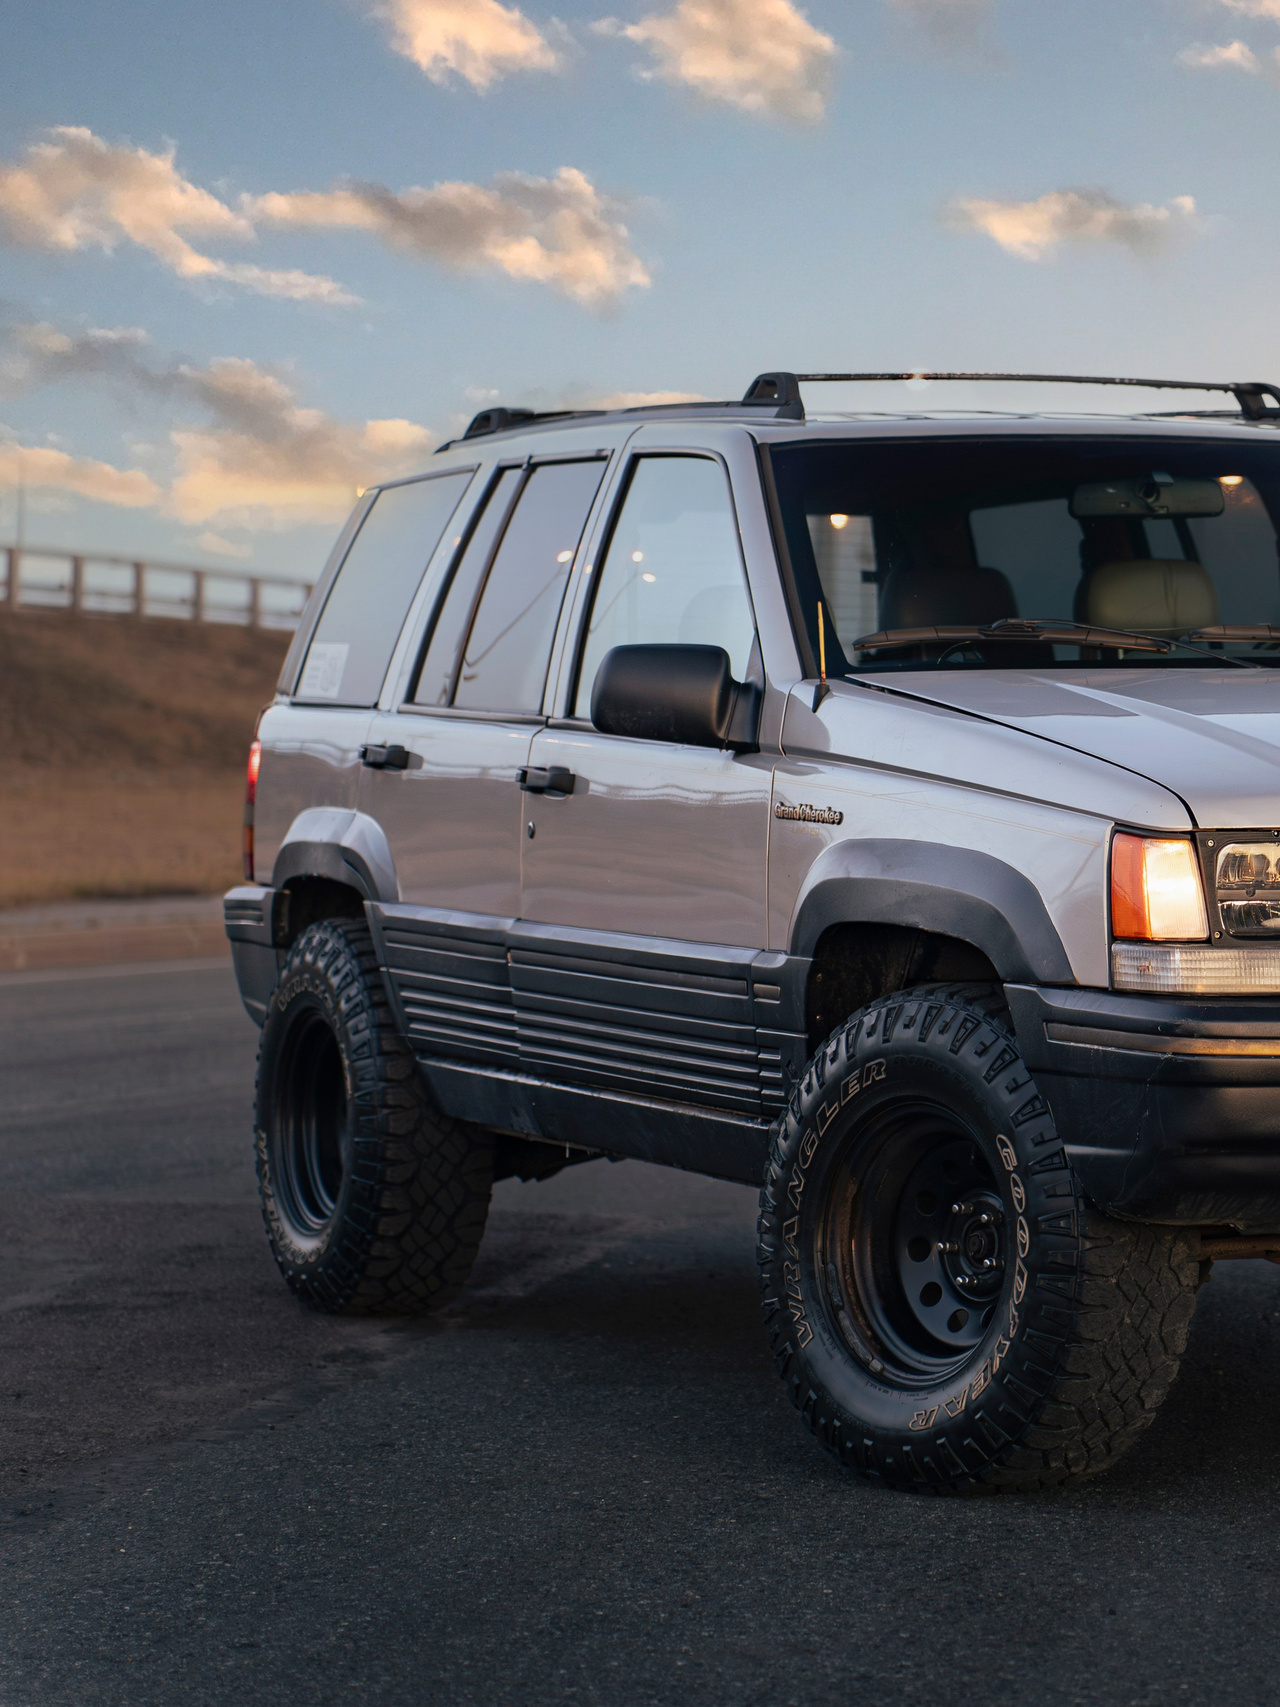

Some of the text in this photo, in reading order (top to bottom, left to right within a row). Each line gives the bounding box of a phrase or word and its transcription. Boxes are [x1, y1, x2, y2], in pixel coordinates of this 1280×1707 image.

[774, 801, 844, 826] Grand Cherokee
[782, 1057, 886, 1349] WRANGLER
[909, 1133, 1031, 1431] GOODYEAR
